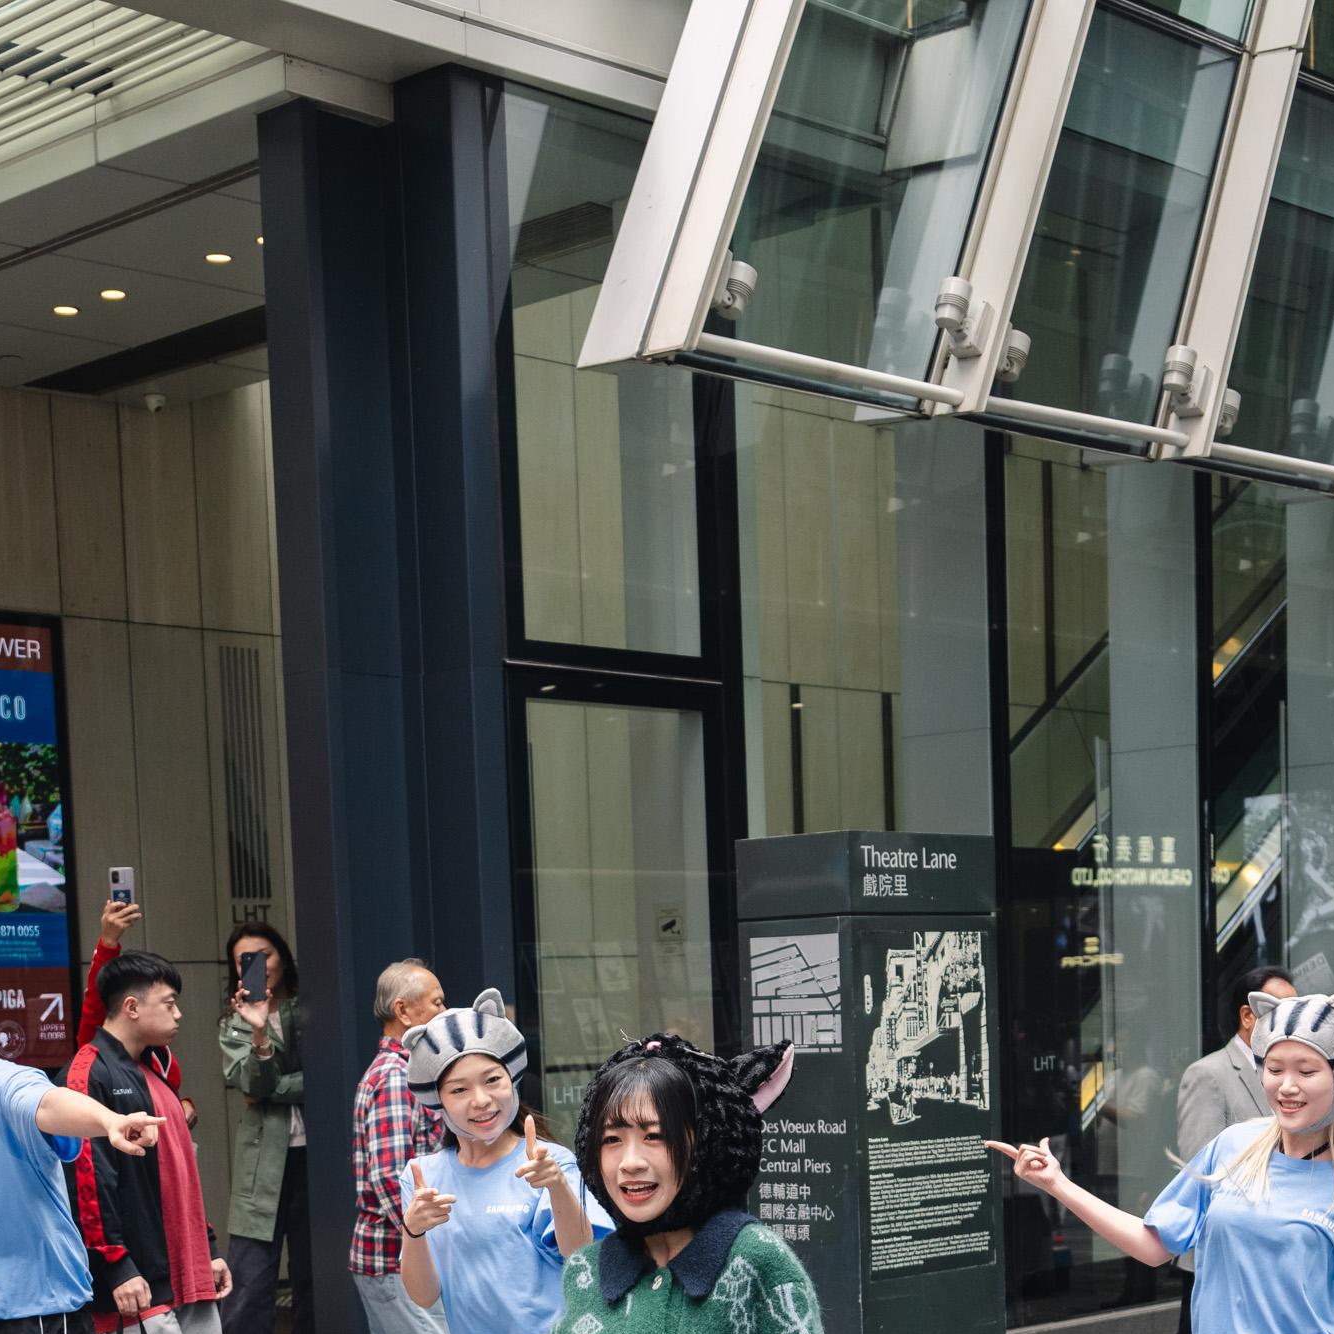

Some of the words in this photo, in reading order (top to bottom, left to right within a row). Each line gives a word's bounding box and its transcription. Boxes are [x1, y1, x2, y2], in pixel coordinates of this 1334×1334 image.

[861, 845, 918, 870] Theatre
[923, 848, 957, 869] Lane
[863, 874, 909, 897] 戲院里
[232, 904, 272, 924] LHT
[18, 926, 40, 937] 0055
[1034, 1056, 1056, 1072] LHT
[780, 1120, 816, 1134] Voeux
[818, 1120, 847, 1134] Road
[761, 1139, 778, 1153] FC
[780, 1139, 806, 1153] Mall
[759, 1158, 801, 1173] Central
[804, 1159, 832, 1174] Piers
[759, 1182, 811, 1200] 德輔道中
[759, 1203, 835, 1221] 國際金融中心
